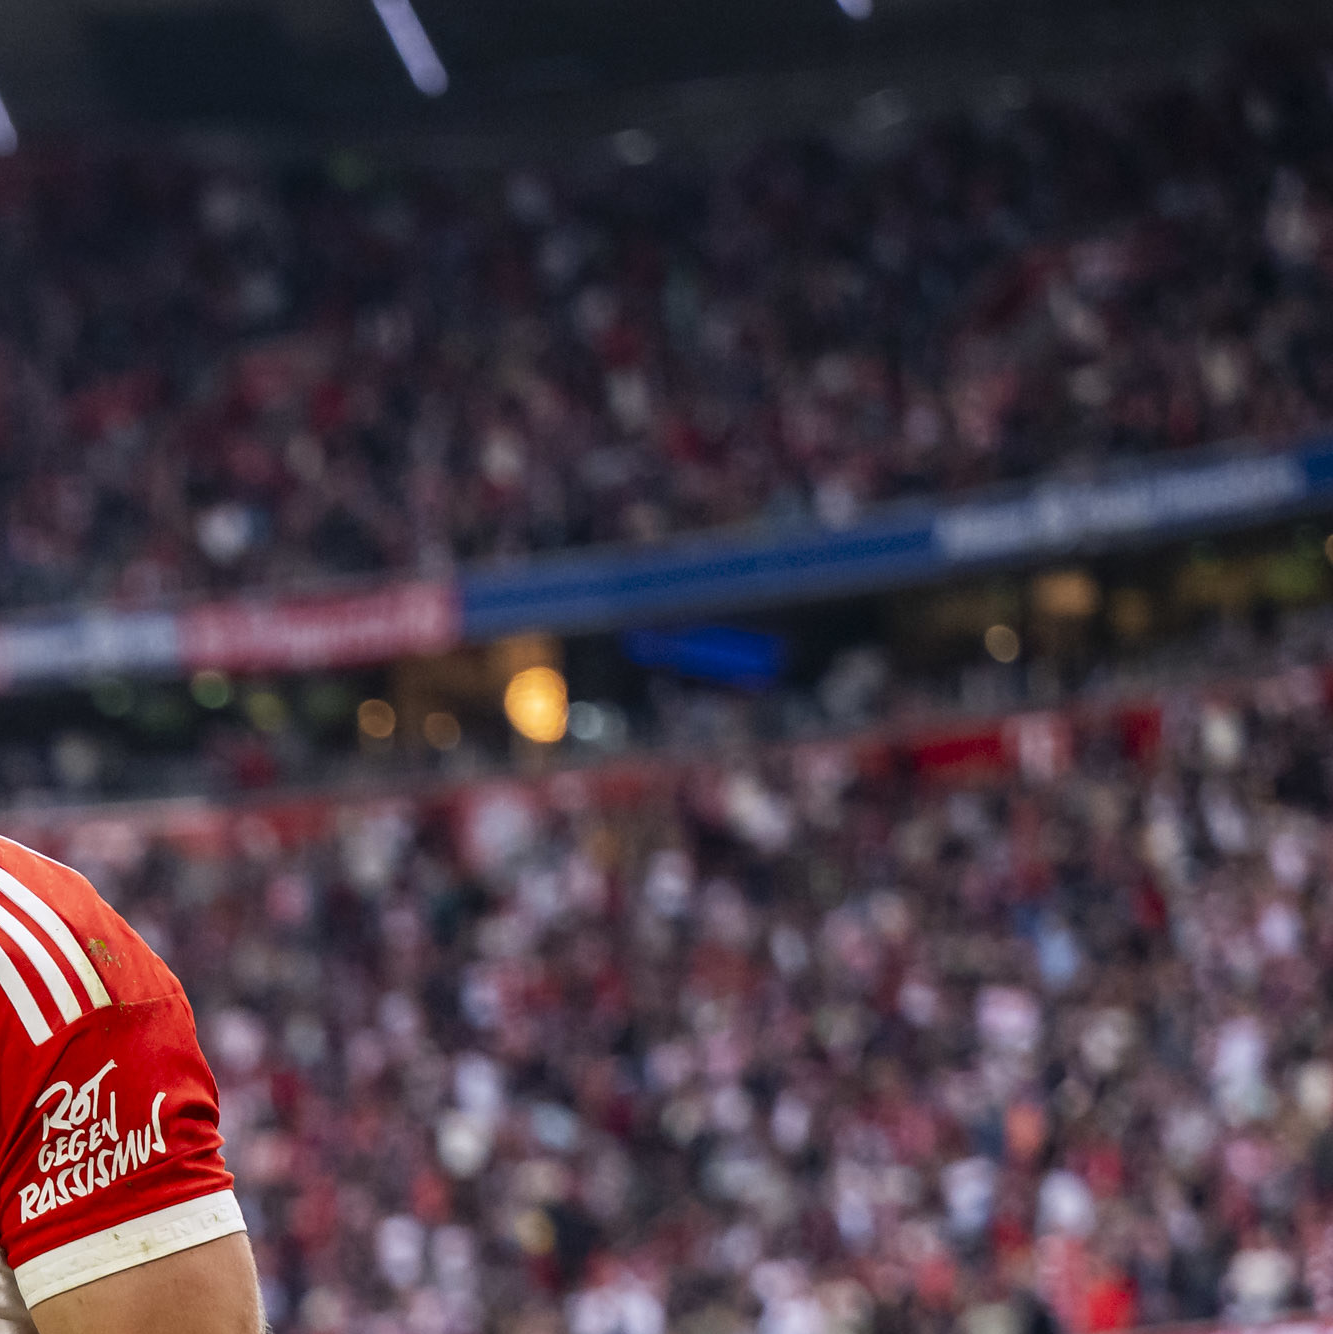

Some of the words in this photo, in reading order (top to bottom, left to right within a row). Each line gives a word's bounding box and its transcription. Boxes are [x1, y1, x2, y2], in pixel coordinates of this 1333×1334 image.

[35, 1058, 118, 1142] ROT
[37, 1090, 120, 1173] GEGEN
[18, 1091, 167, 1224] RASSISMUS
